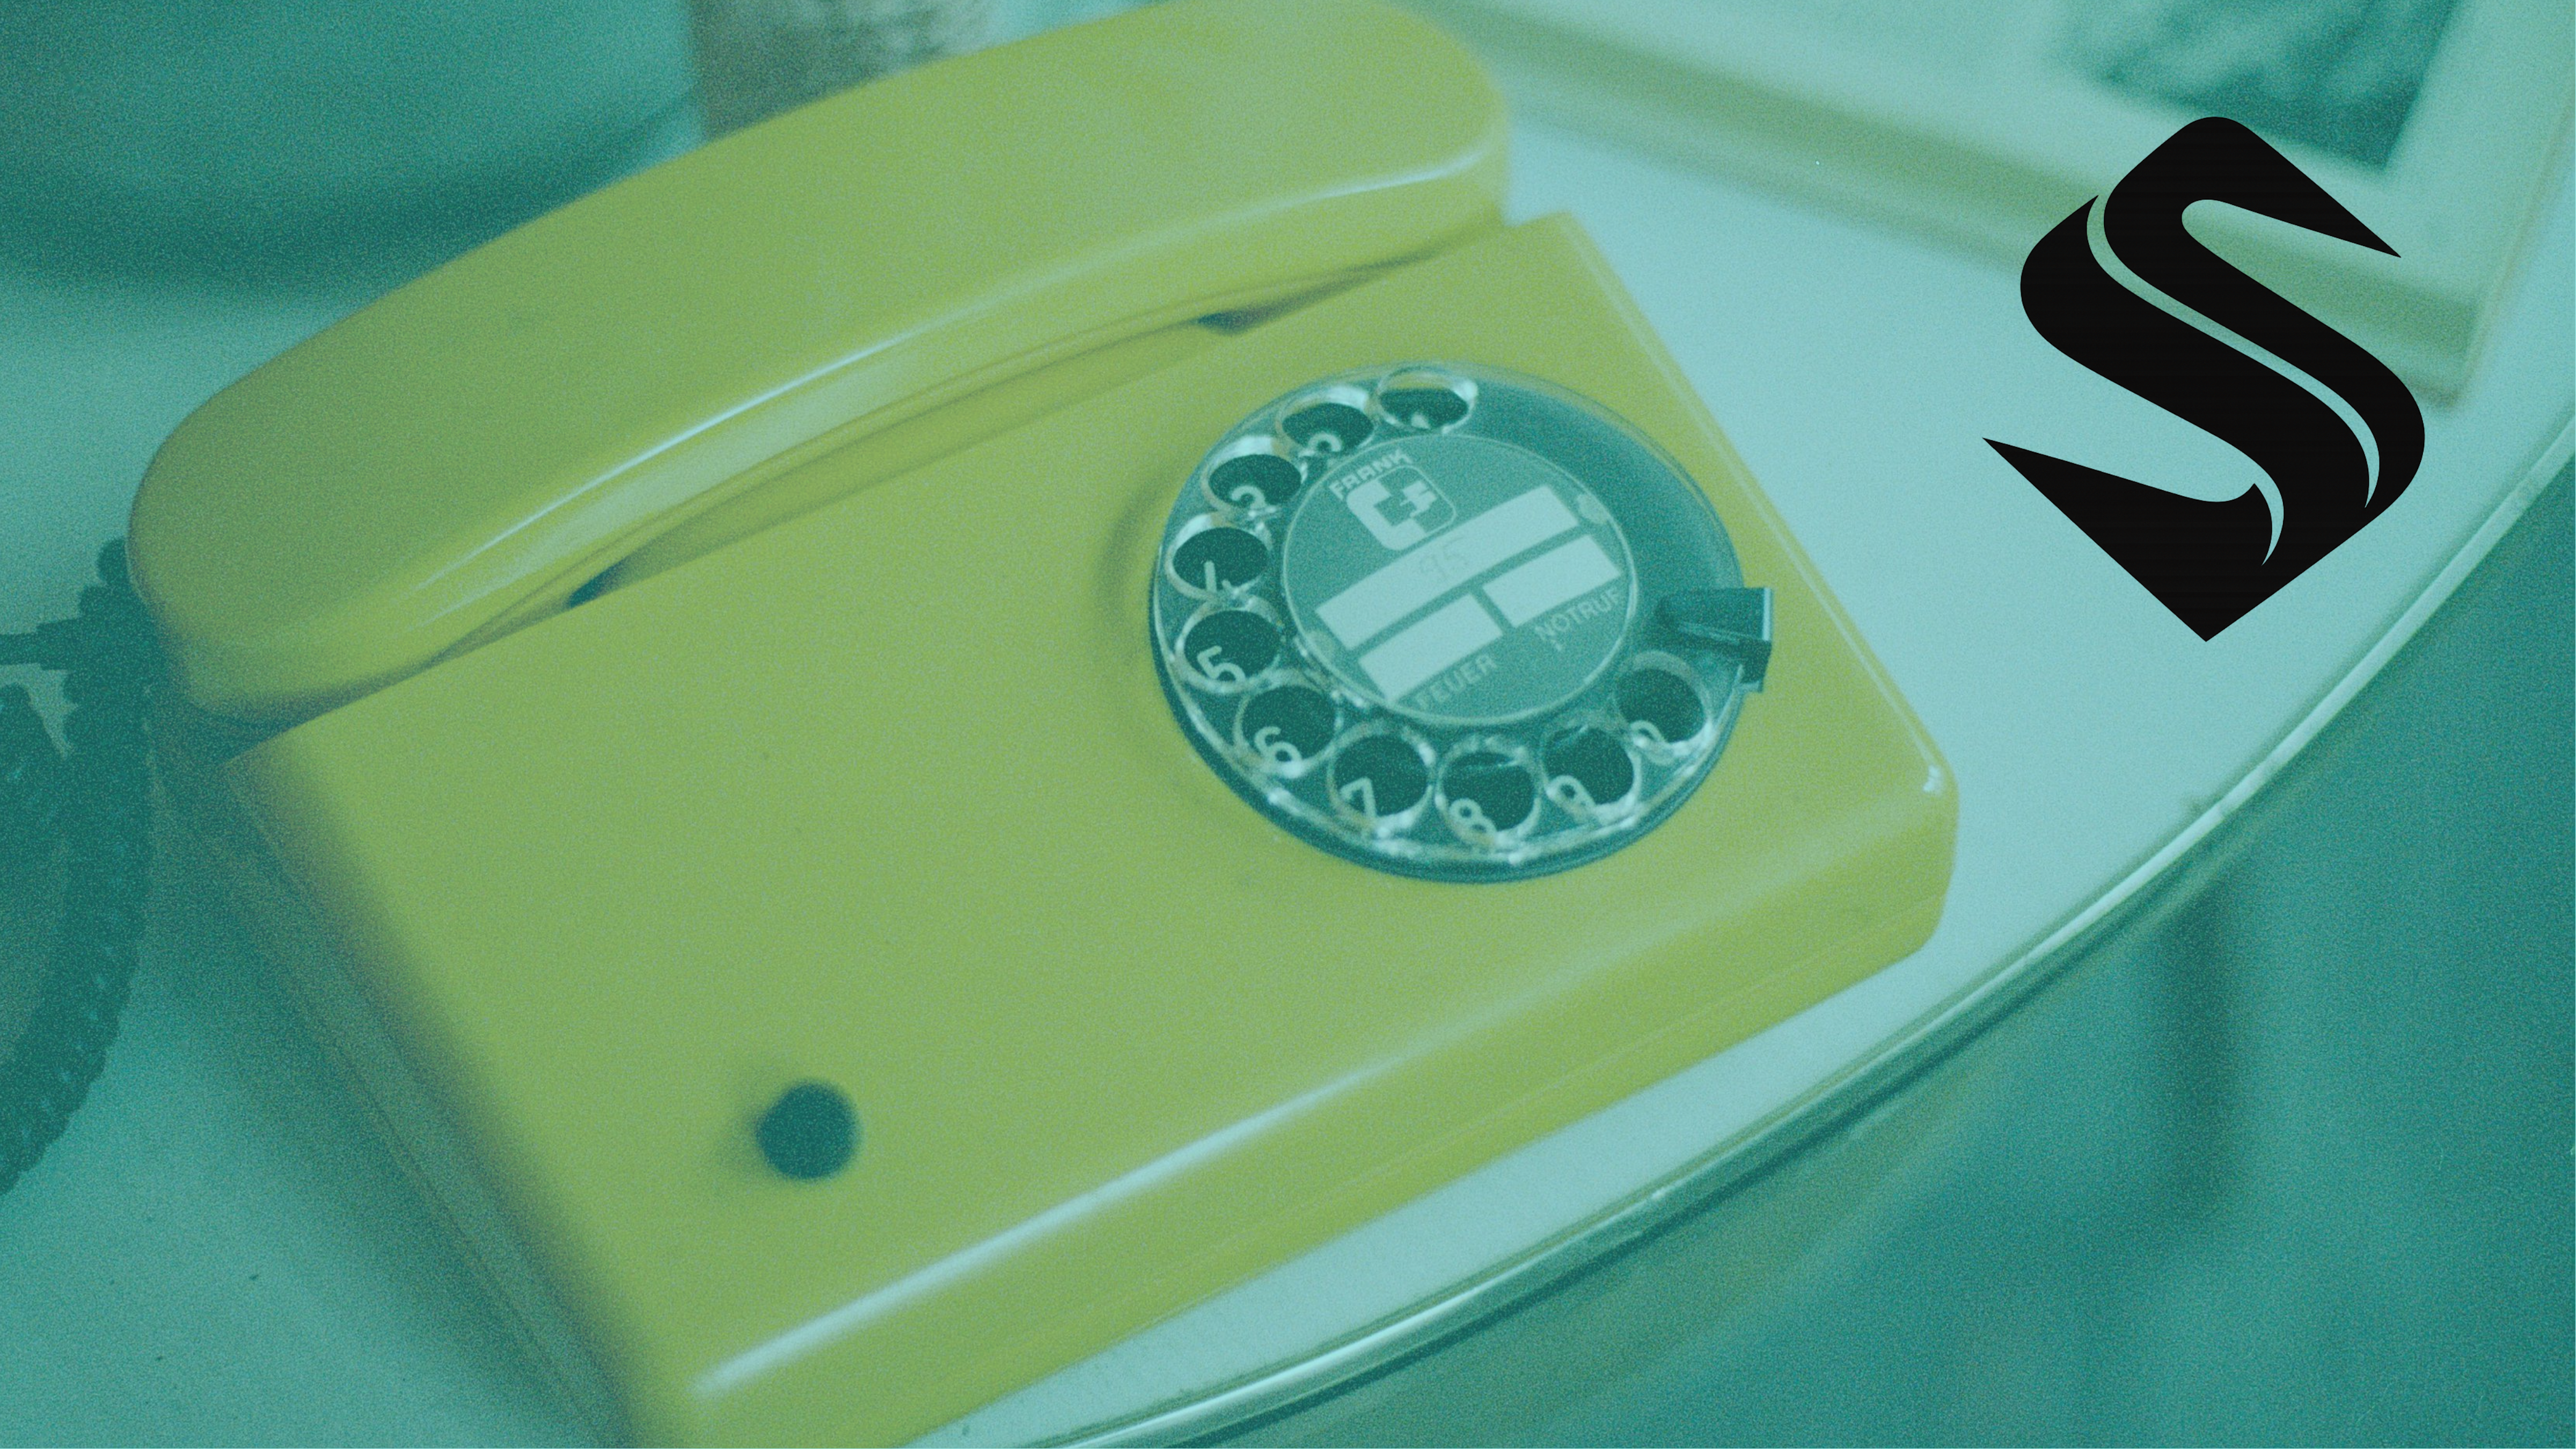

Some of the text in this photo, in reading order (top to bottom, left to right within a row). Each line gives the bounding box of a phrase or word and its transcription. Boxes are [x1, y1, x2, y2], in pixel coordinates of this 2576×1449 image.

[1328, 449, 1413, 501] FRANK
[1534, 586, 1624, 643] NOTRUF
[1197, 645, 1246, 692] 5
[1414, 653, 1498, 711] FEUER
[1254, 725, 1302, 773] 6
[1339, 776, 1377, 829] 7
[1449, 797, 1497, 845] 8
[1547, 774, 1596, 821] 9
